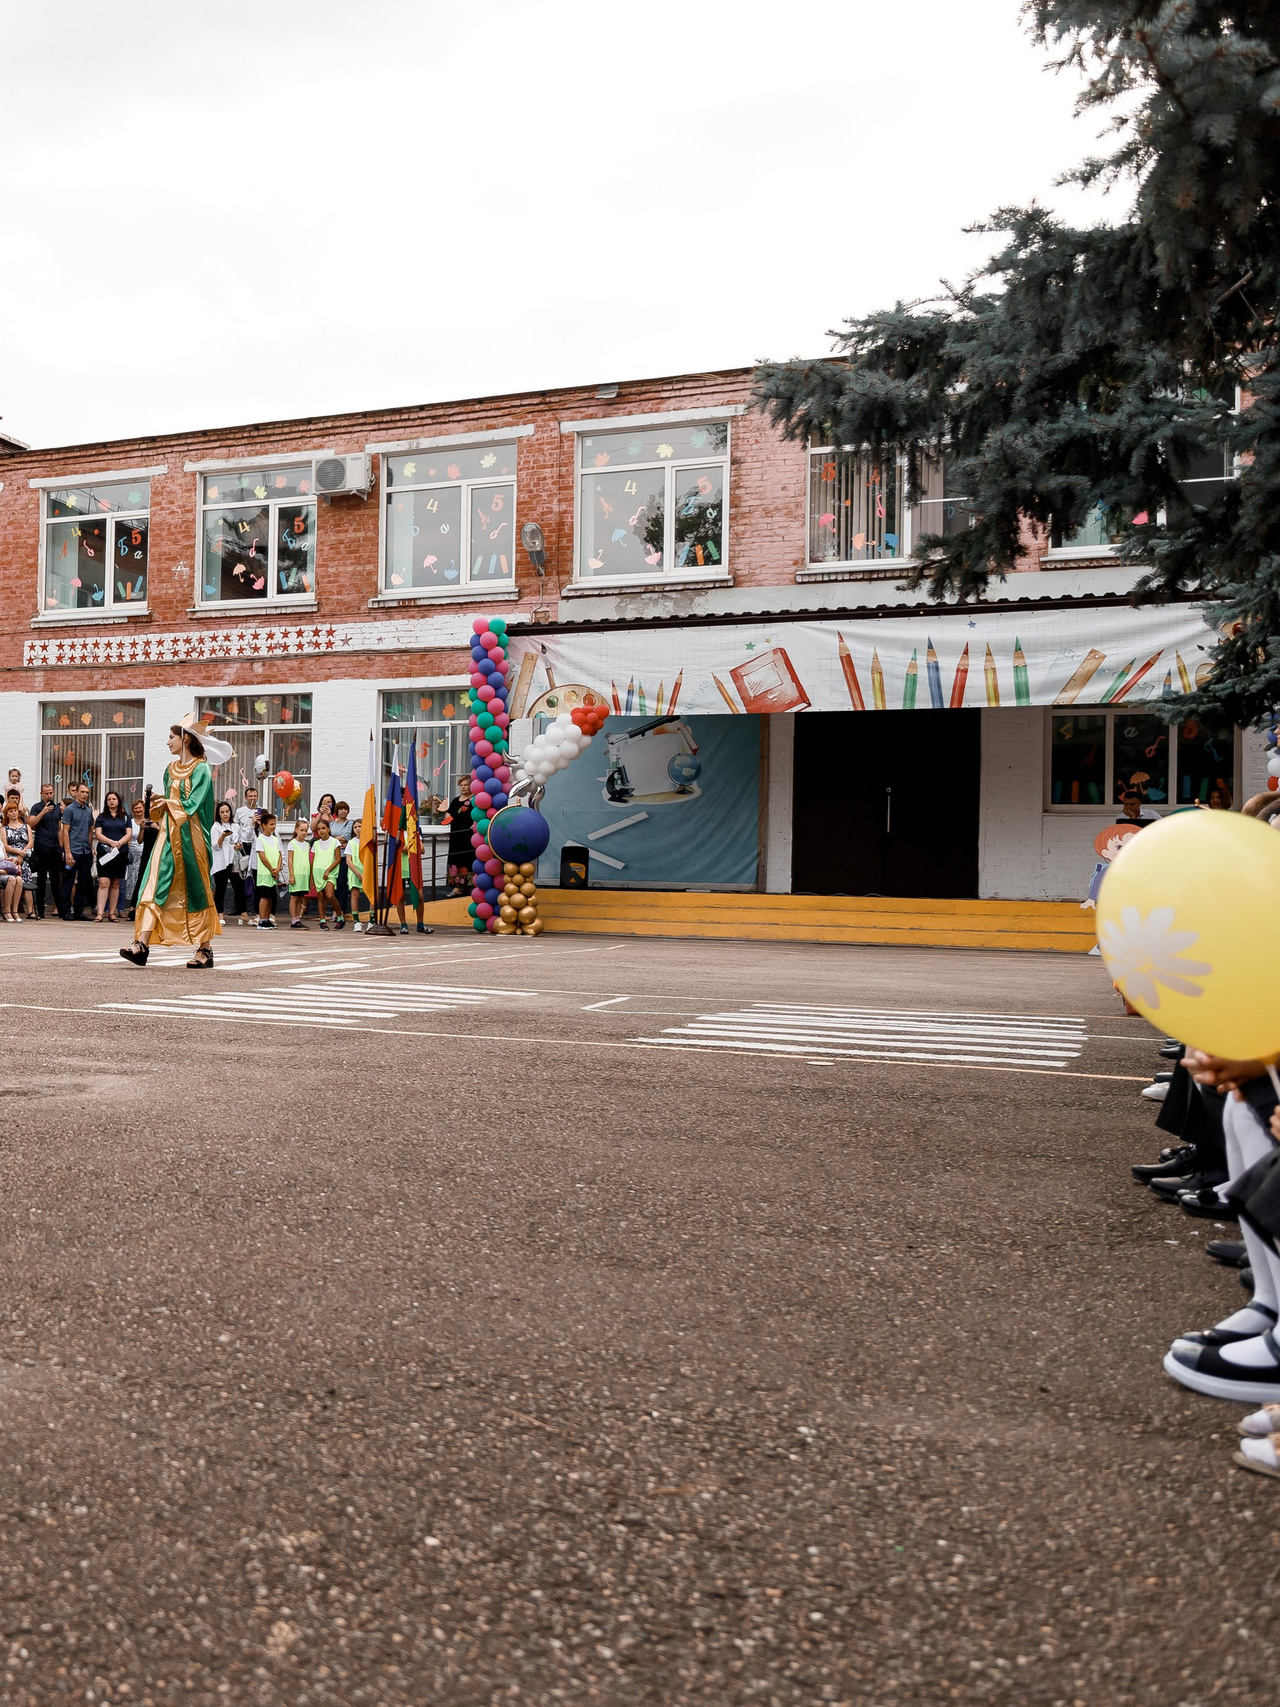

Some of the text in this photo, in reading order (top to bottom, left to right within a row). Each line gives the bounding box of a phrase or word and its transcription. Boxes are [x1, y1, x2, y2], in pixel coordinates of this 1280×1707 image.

[821, 462, 837, 482] 5
[624, 480, 637, 495] 4
[697, 475, 712, 495] 5
[426, 498, 438, 514] 4
[491, 493, 505, 512] 5
[71, 526, 82, 538] 4
[238, 521, 250, 534] 4
[293, 516, 305, 534] 5
[131, 528, 142, 545] 5
[126, 749, 136, 761] 4
[416, 741, 431, 759] 5
